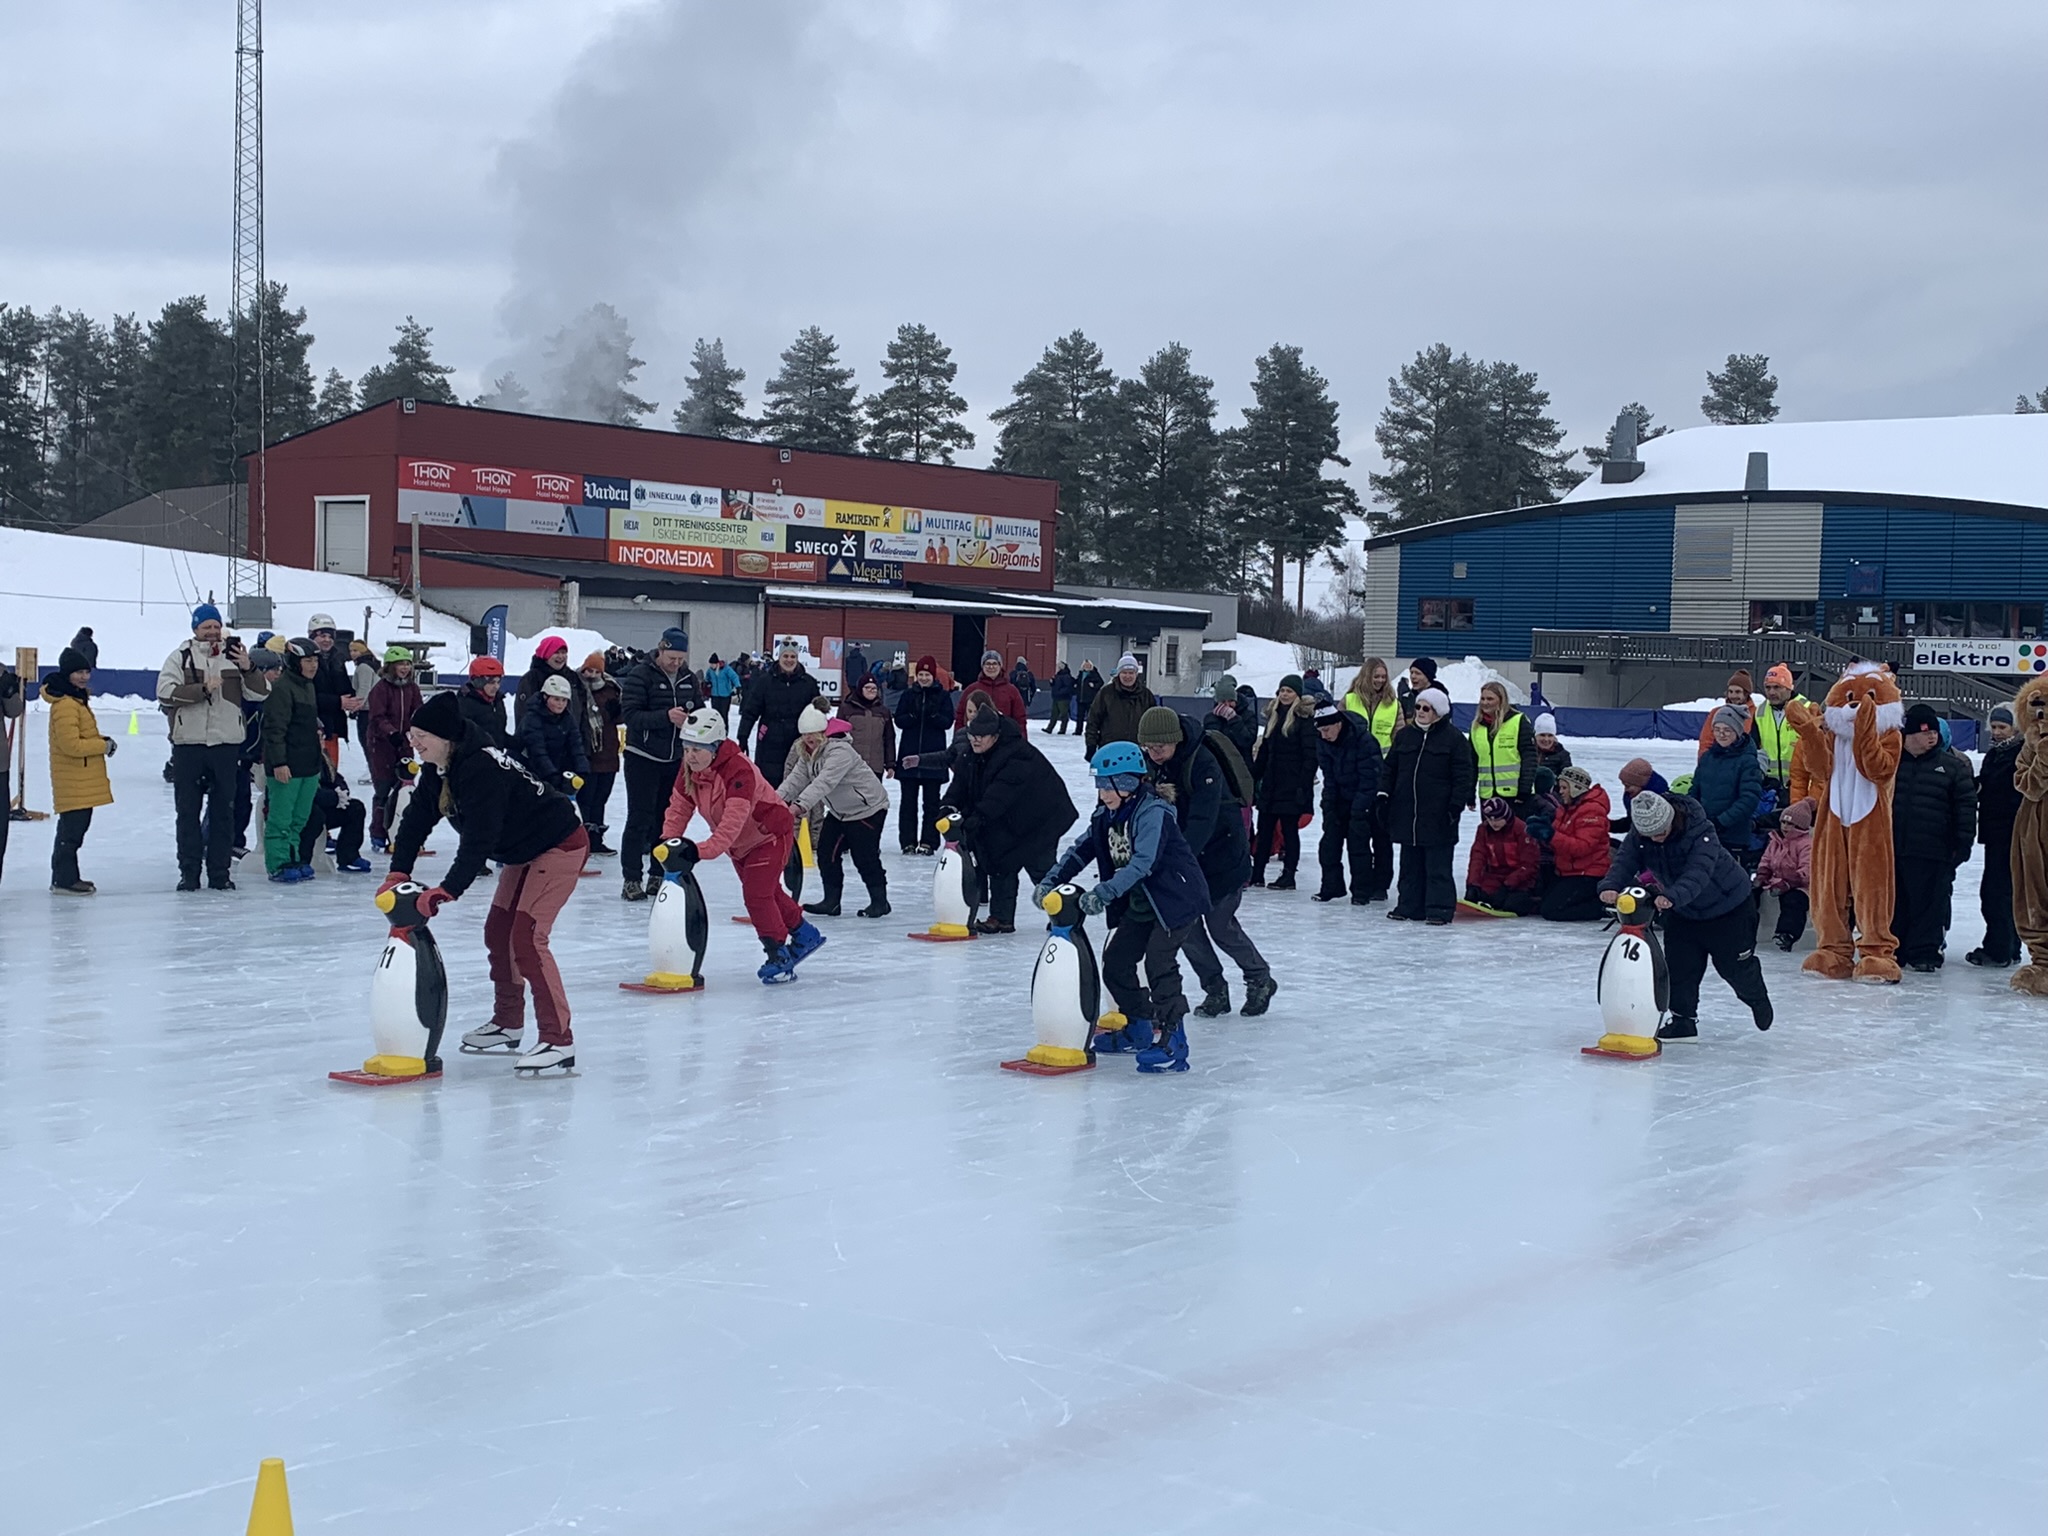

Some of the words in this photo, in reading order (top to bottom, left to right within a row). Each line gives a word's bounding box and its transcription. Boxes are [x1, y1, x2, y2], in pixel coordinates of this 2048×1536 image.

[408, 461, 456, 480] THON
[471, 467, 516, 486] THON
[413, 478, 430, 487] Hotel
[475, 484, 491, 493] Hotel
[532, 474, 575, 492] THON
[584, 480, 630, 502] Varden
[535, 490, 551, 498] Hotel
[634, 487, 646, 500] GK
[648, 490, 687, 502] INNEKLIMA
[690, 492, 702, 506] GK
[653, 517, 672, 528] DITT
[674, 518, 748, 534] TRENINGSSENTER
[835, 512, 881, 528] RAMIRENT
[925, 517, 972, 532] MULTIFAG
[657, 529, 687, 541] SKIEN
[687, 530, 748, 546] FRITIDSPARK
[995, 524, 1039, 539] MULTIFAG
[794, 540, 838, 555] SWECO
[618, 546, 714, 569] INFORMEDIA
[852, 560, 903, 583] MegaFlis
[1961, 641, 1974, 649] PÅ
[1916, 650, 2010, 667] elektro
[658, 885, 668, 903] 6
[380, 945, 396, 969] 11
[1045, 943, 1058, 964] 8
[1621, 938, 1641, 962] 16
